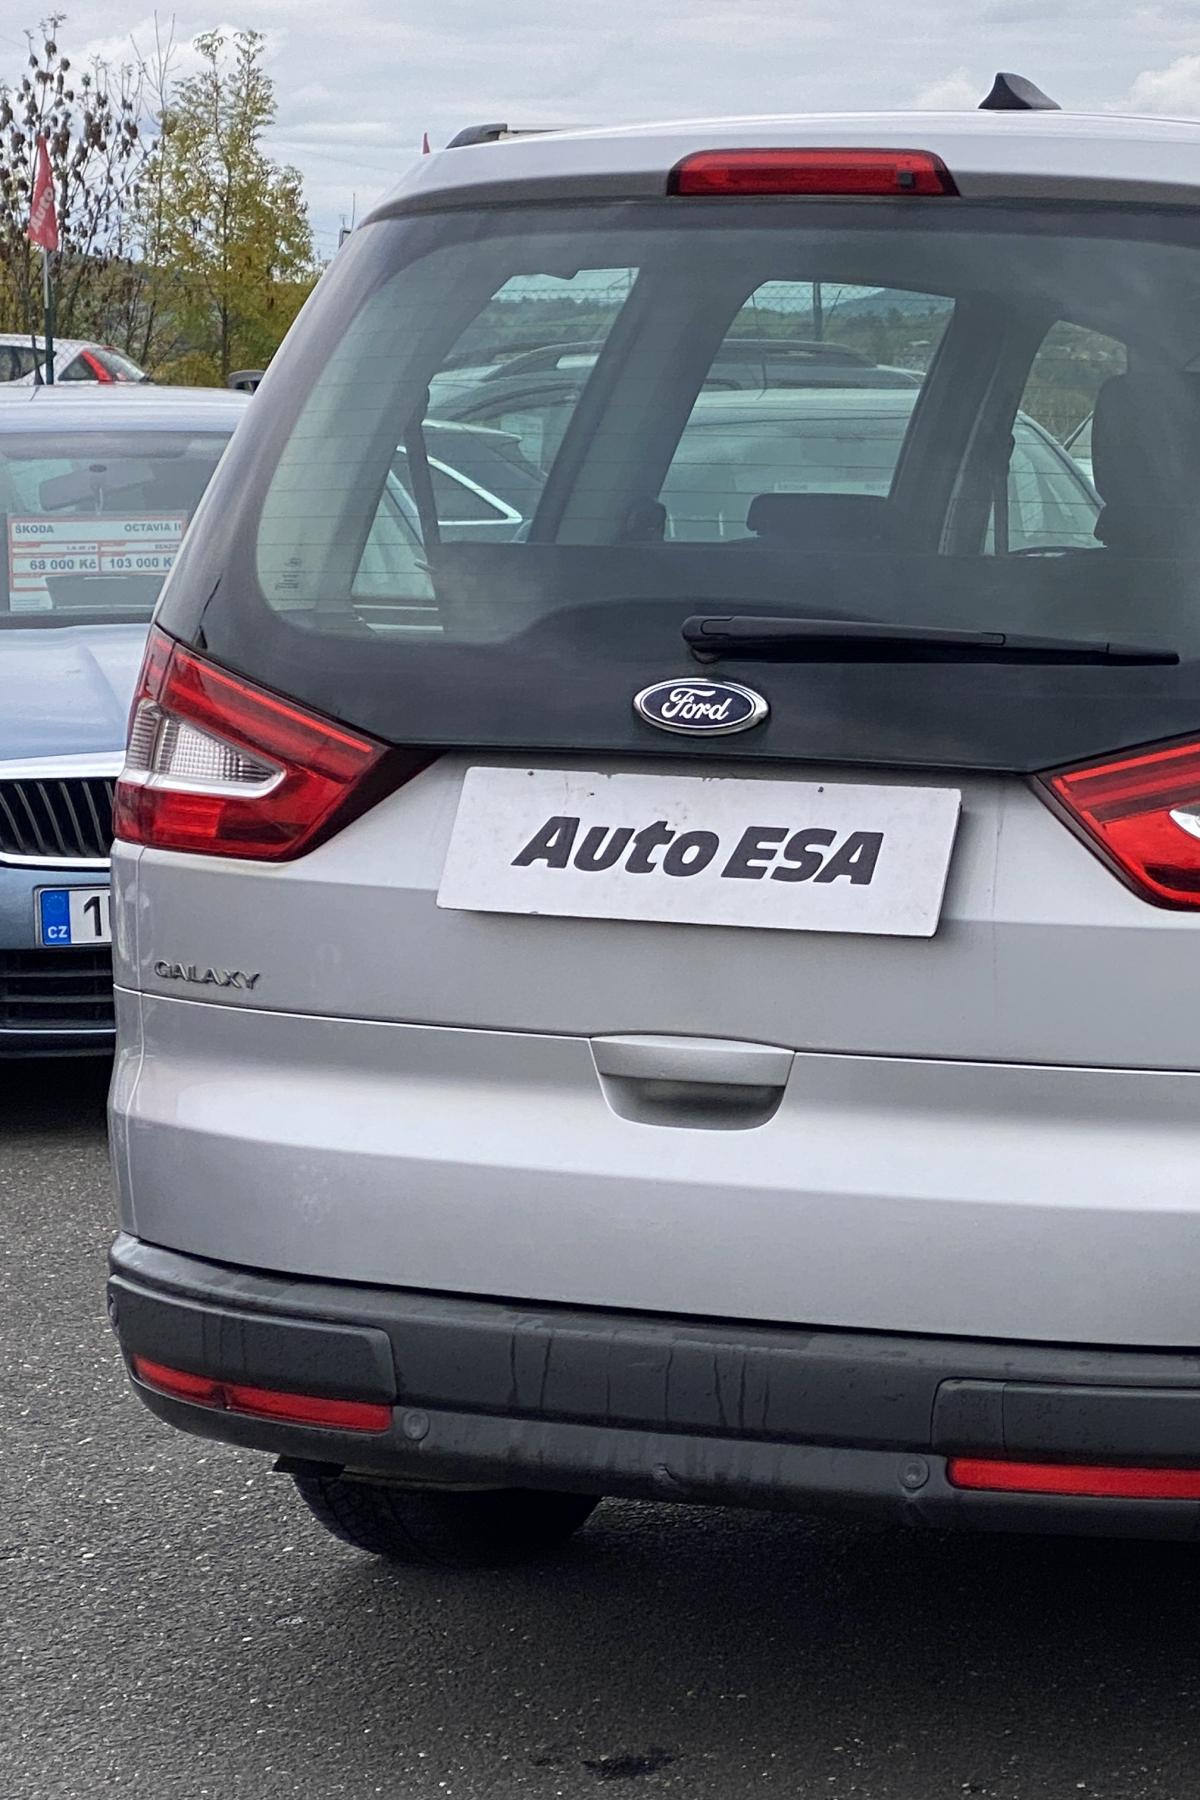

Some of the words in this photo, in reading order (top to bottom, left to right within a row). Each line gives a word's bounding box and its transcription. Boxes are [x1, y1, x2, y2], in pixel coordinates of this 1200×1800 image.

[15, 523, 54, 534] ŠKODA
[124, 522, 171, 532] OCTAVIA
[30, 559, 46, 570] 68
[50, 559, 75, 570] 000
[110, 557, 132, 569] 103
[136, 557, 159, 568] 000
[659, 686, 733, 722] Ford
[511, 815, 720, 878] Auto
[721, 826, 884, 885] ESA
[47, 925, 68, 939] CZ
[154, 960, 262, 990] GALAXY
